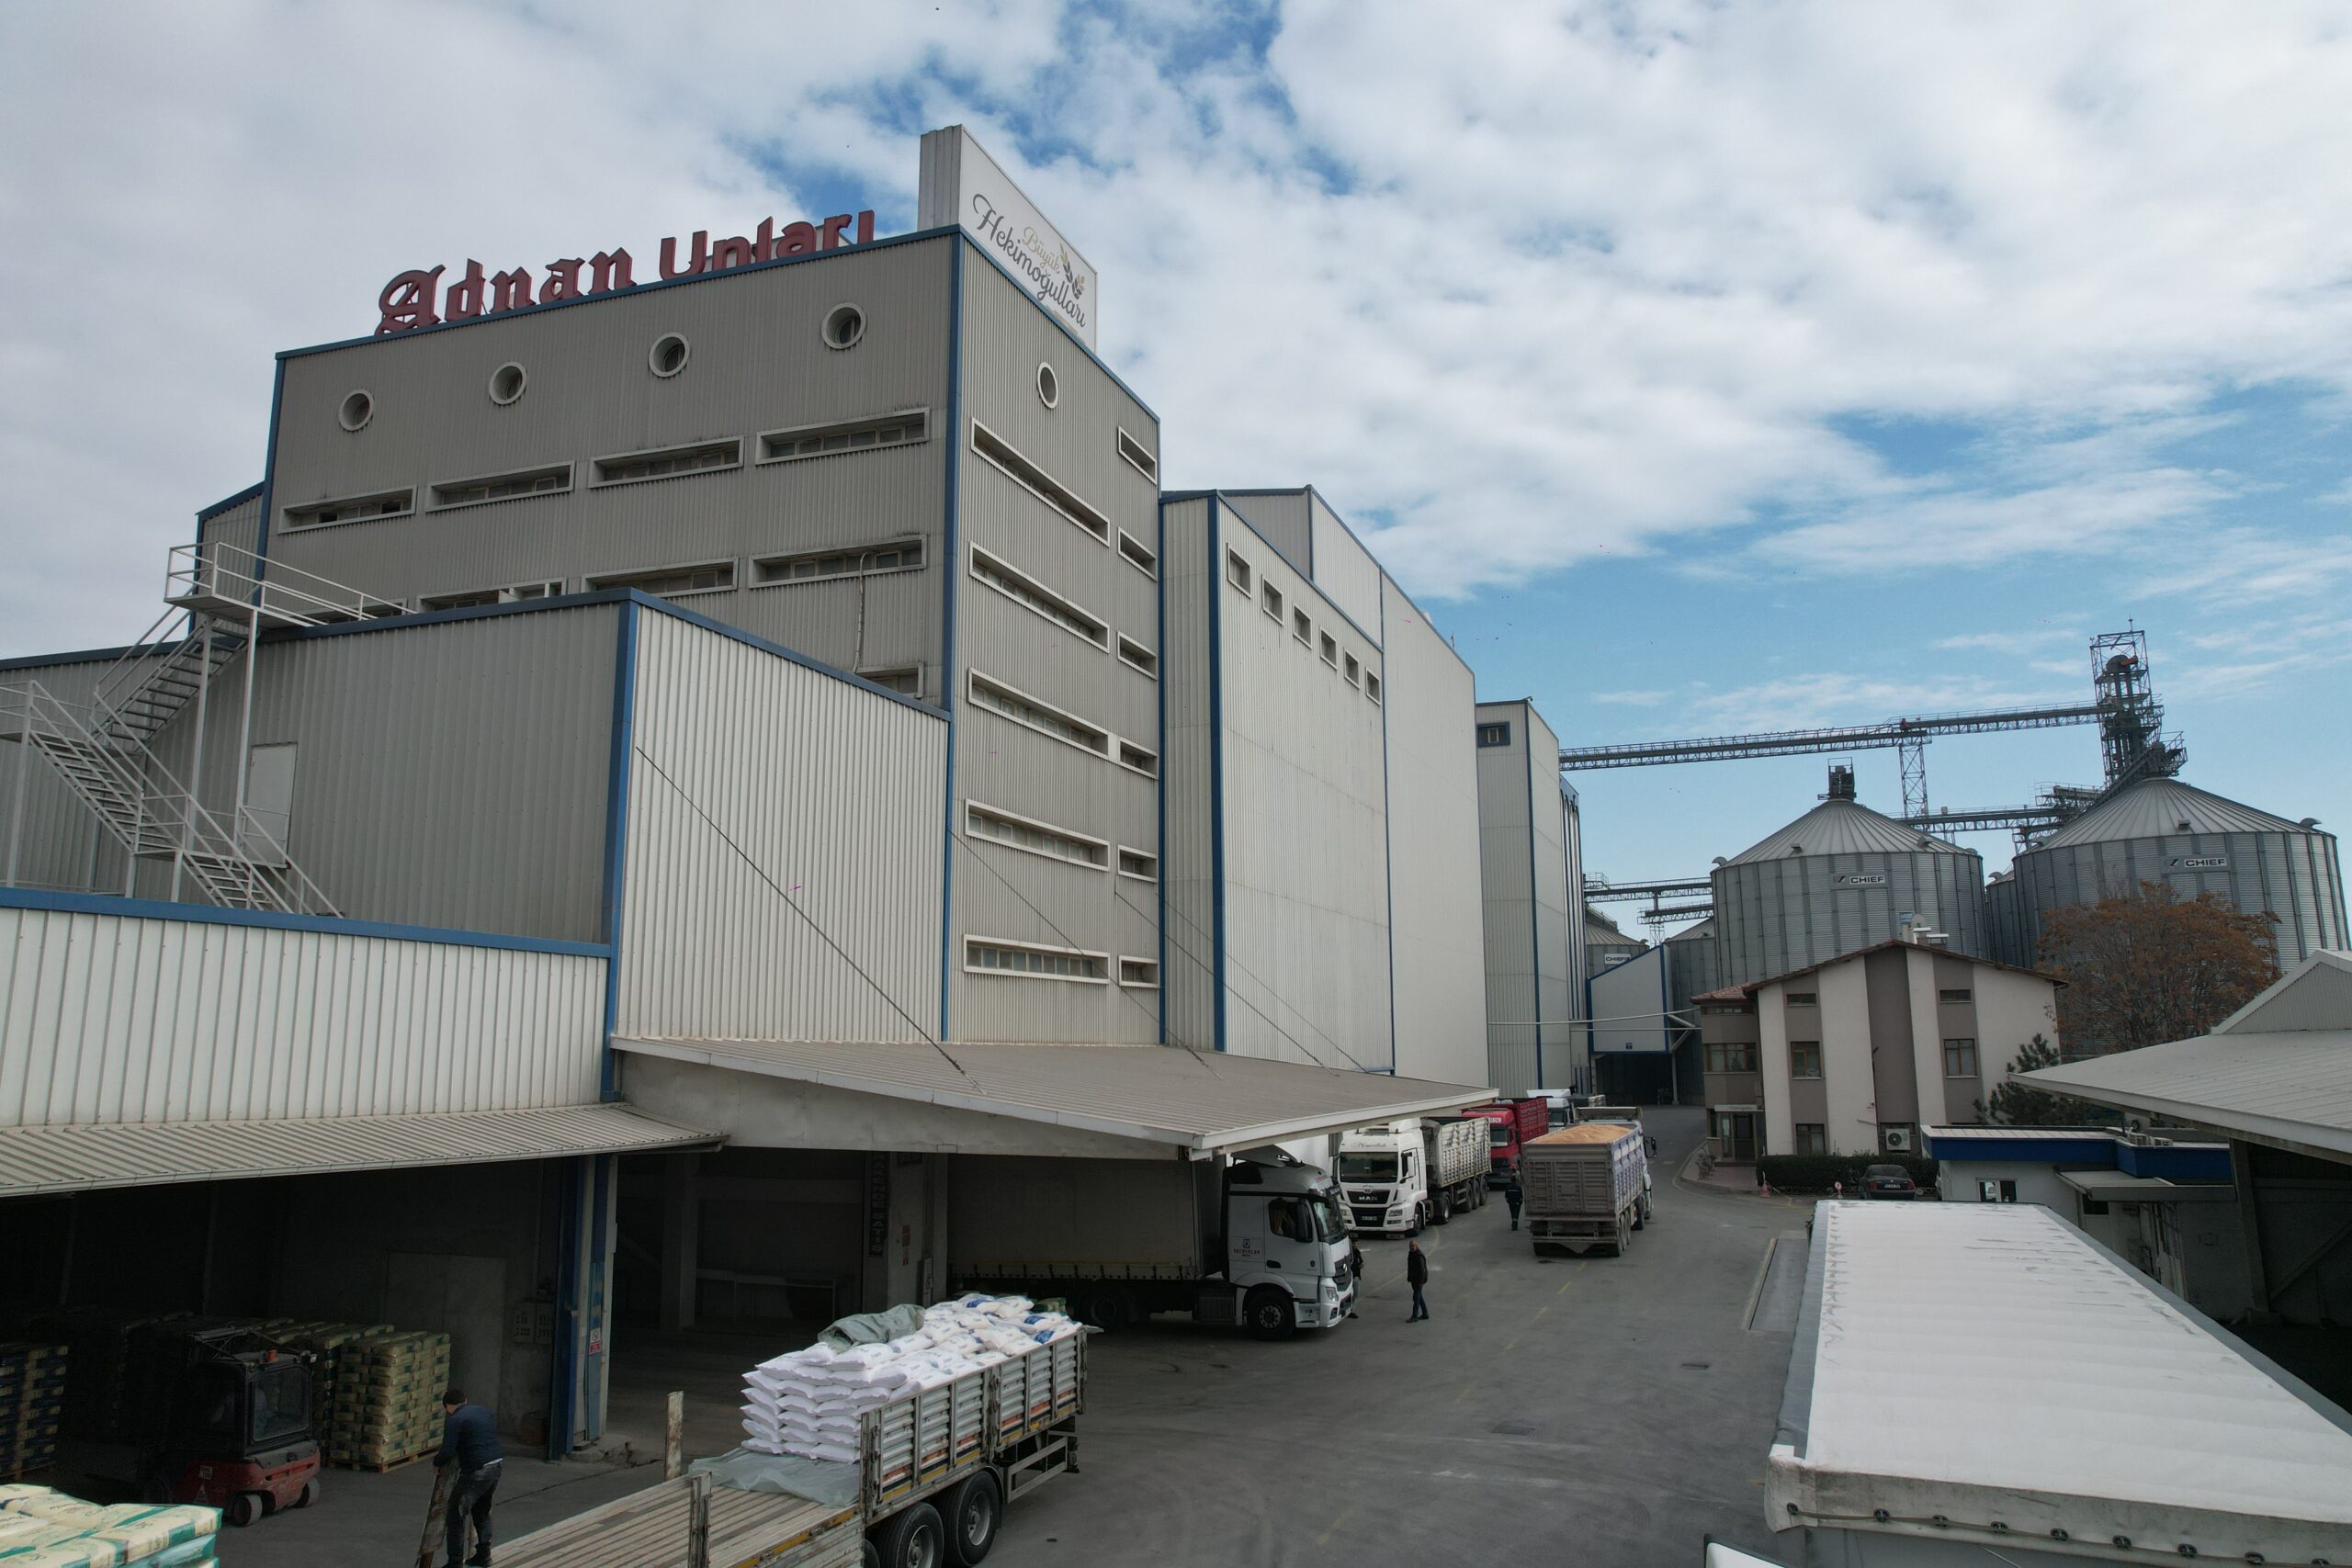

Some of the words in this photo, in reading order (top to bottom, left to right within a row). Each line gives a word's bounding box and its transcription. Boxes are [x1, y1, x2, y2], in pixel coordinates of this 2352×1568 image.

[973, 194, 1086, 328] Hekimoğulları
[1022, 226, 1060, 275] Büyük
[374, 247, 638, 336] Adnan
[1850, 875, 1884, 884] CHIEF
[2186, 858, 2226, 867] CHIEF
